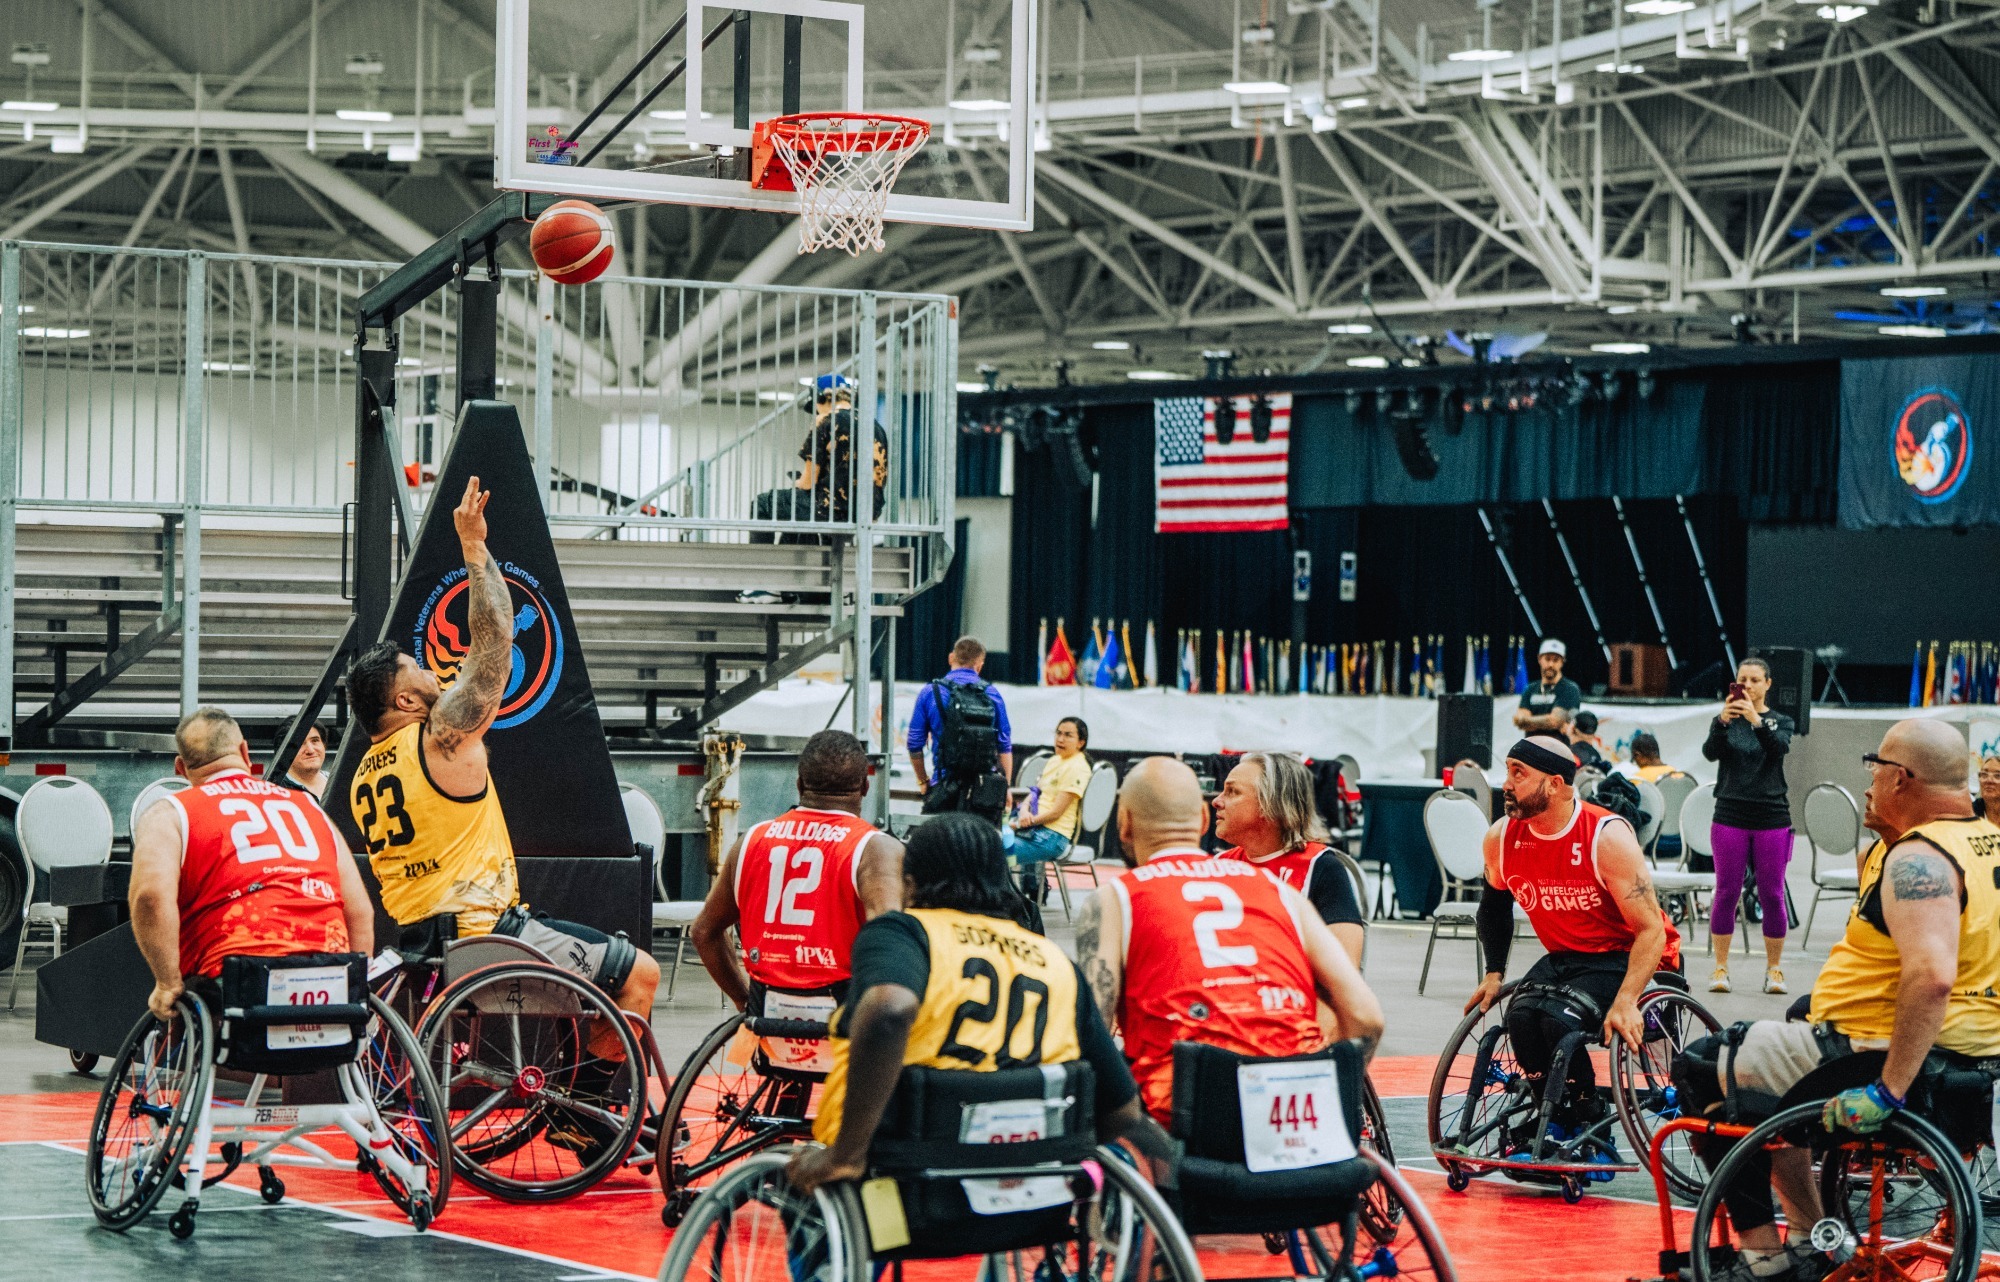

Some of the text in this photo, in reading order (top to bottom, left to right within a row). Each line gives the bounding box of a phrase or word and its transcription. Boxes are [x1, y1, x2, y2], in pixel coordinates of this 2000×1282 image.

[528, 138, 551, 148] First
[414, 585, 444, 633] Veterans
[504, 561, 540, 588] Games
[200, 778, 291, 798] BULLDOGS
[356, 773, 415, 854] 23
[219, 798, 320, 864] 20
[764, 820, 851, 842] BULLDOGS
[1131, 858, 1257, 882] BULLDOGS
[1571, 842, 1582, 866] 5
[764, 845, 824, 927] 12
[1539, 885, 1597, 896] WHEELCHAIR
[1541, 892, 1602, 911] GAMES
[1181, 880, 1259, 968] 2
[937, 956, 1049, 1069] 20
[1269, 1093, 1318, 1133] 444
